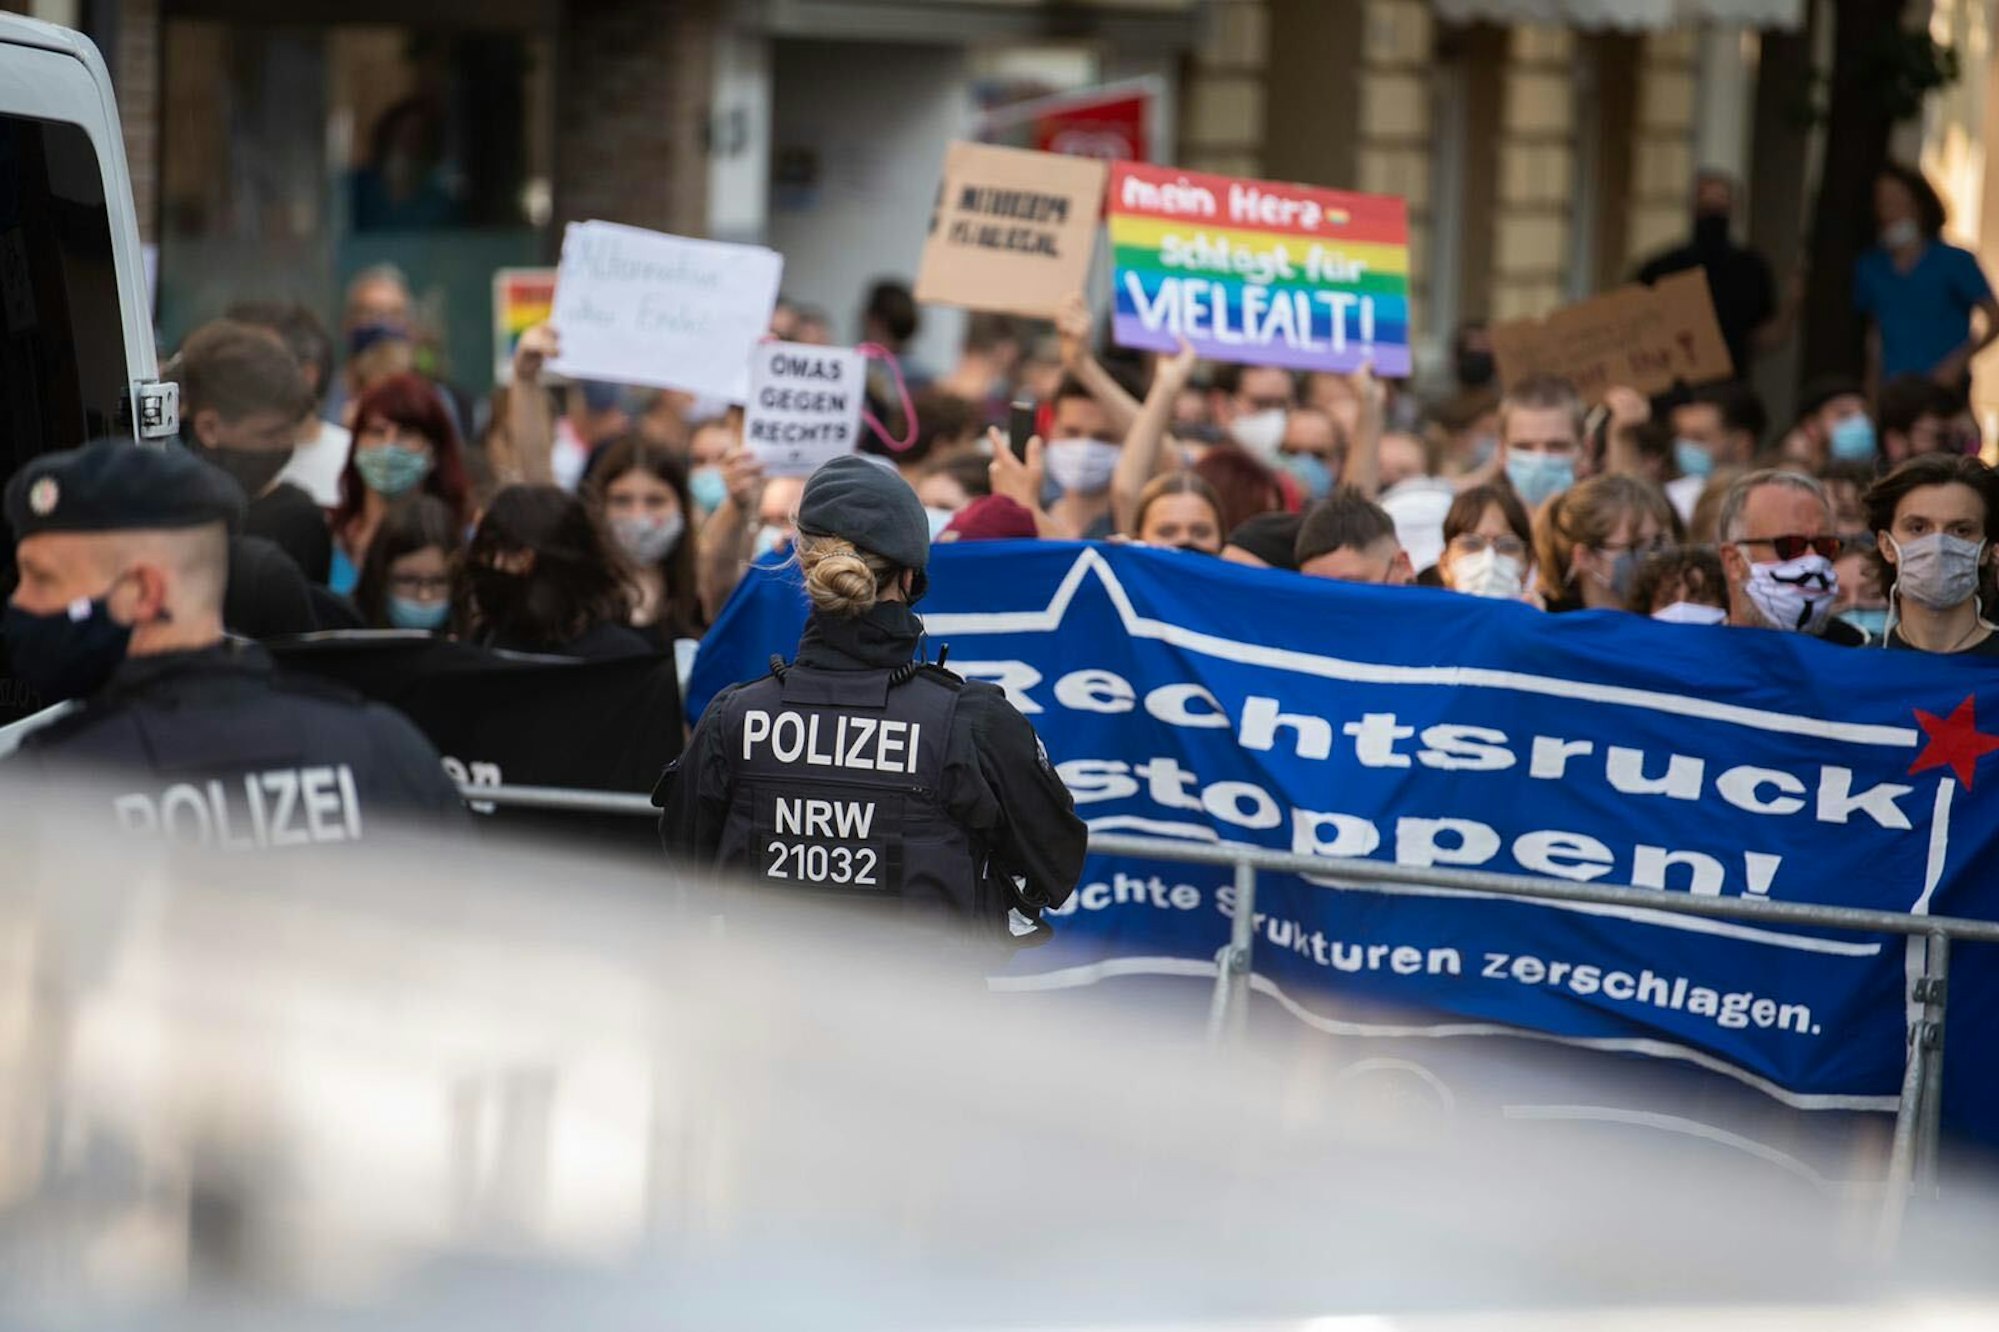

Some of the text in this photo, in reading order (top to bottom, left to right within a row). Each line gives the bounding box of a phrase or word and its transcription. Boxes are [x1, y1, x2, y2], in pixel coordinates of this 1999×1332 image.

[1123, 270, 1376, 355] VIELFALT!
[769, 353, 842, 379] OMAS
[750, 419, 847, 443] RECHTS
[759, 387, 848, 412] GEGEN
[743, 710, 920, 774] POLIZEI
[943, 660, 1914, 830] Rechtsruck
[115, 764, 363, 852] POLIZEI
[775, 797, 875, 839] NRW
[1054, 758, 1783, 900] stoppen!
[767, 841, 877, 885] 21032
[1040, 873, 1821, 1034] chte Srukturen zerschlagen.
